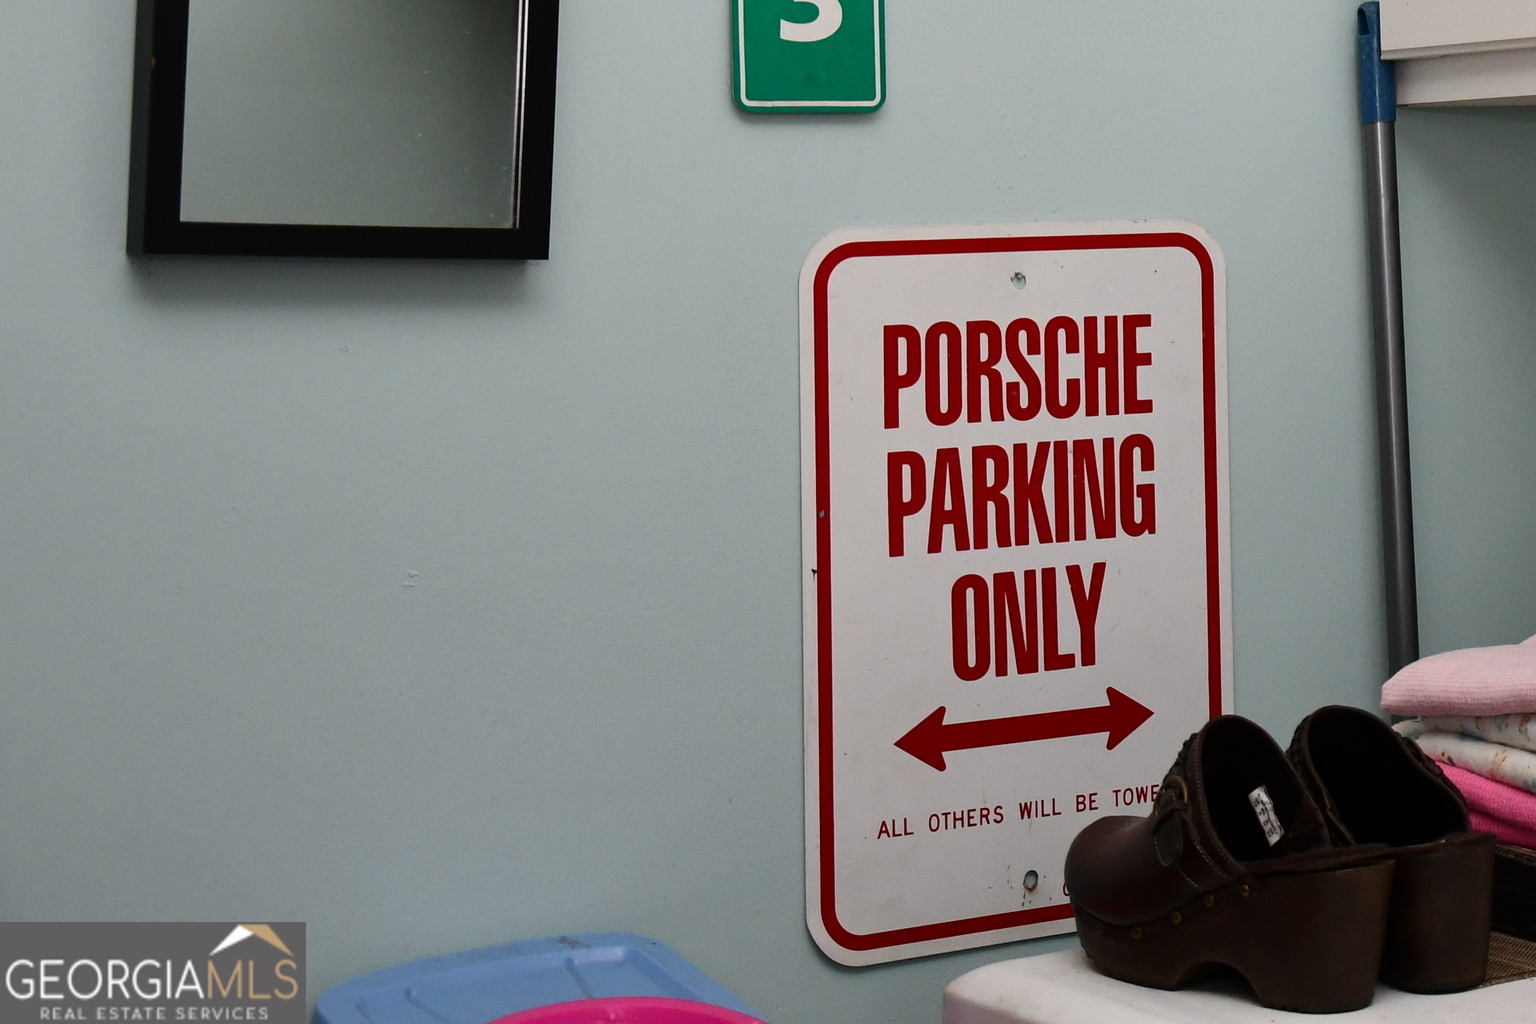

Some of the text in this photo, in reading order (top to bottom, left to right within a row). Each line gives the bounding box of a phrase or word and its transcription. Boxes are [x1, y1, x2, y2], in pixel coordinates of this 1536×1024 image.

[882, 314, 1154, 430] PORSCHE
[887, 433, 1157, 558] PARKING
[951, 562, 1107, 682] ONLY
[877, 784, 1160, 839] ALL OTHERS WILL BE TOWE
